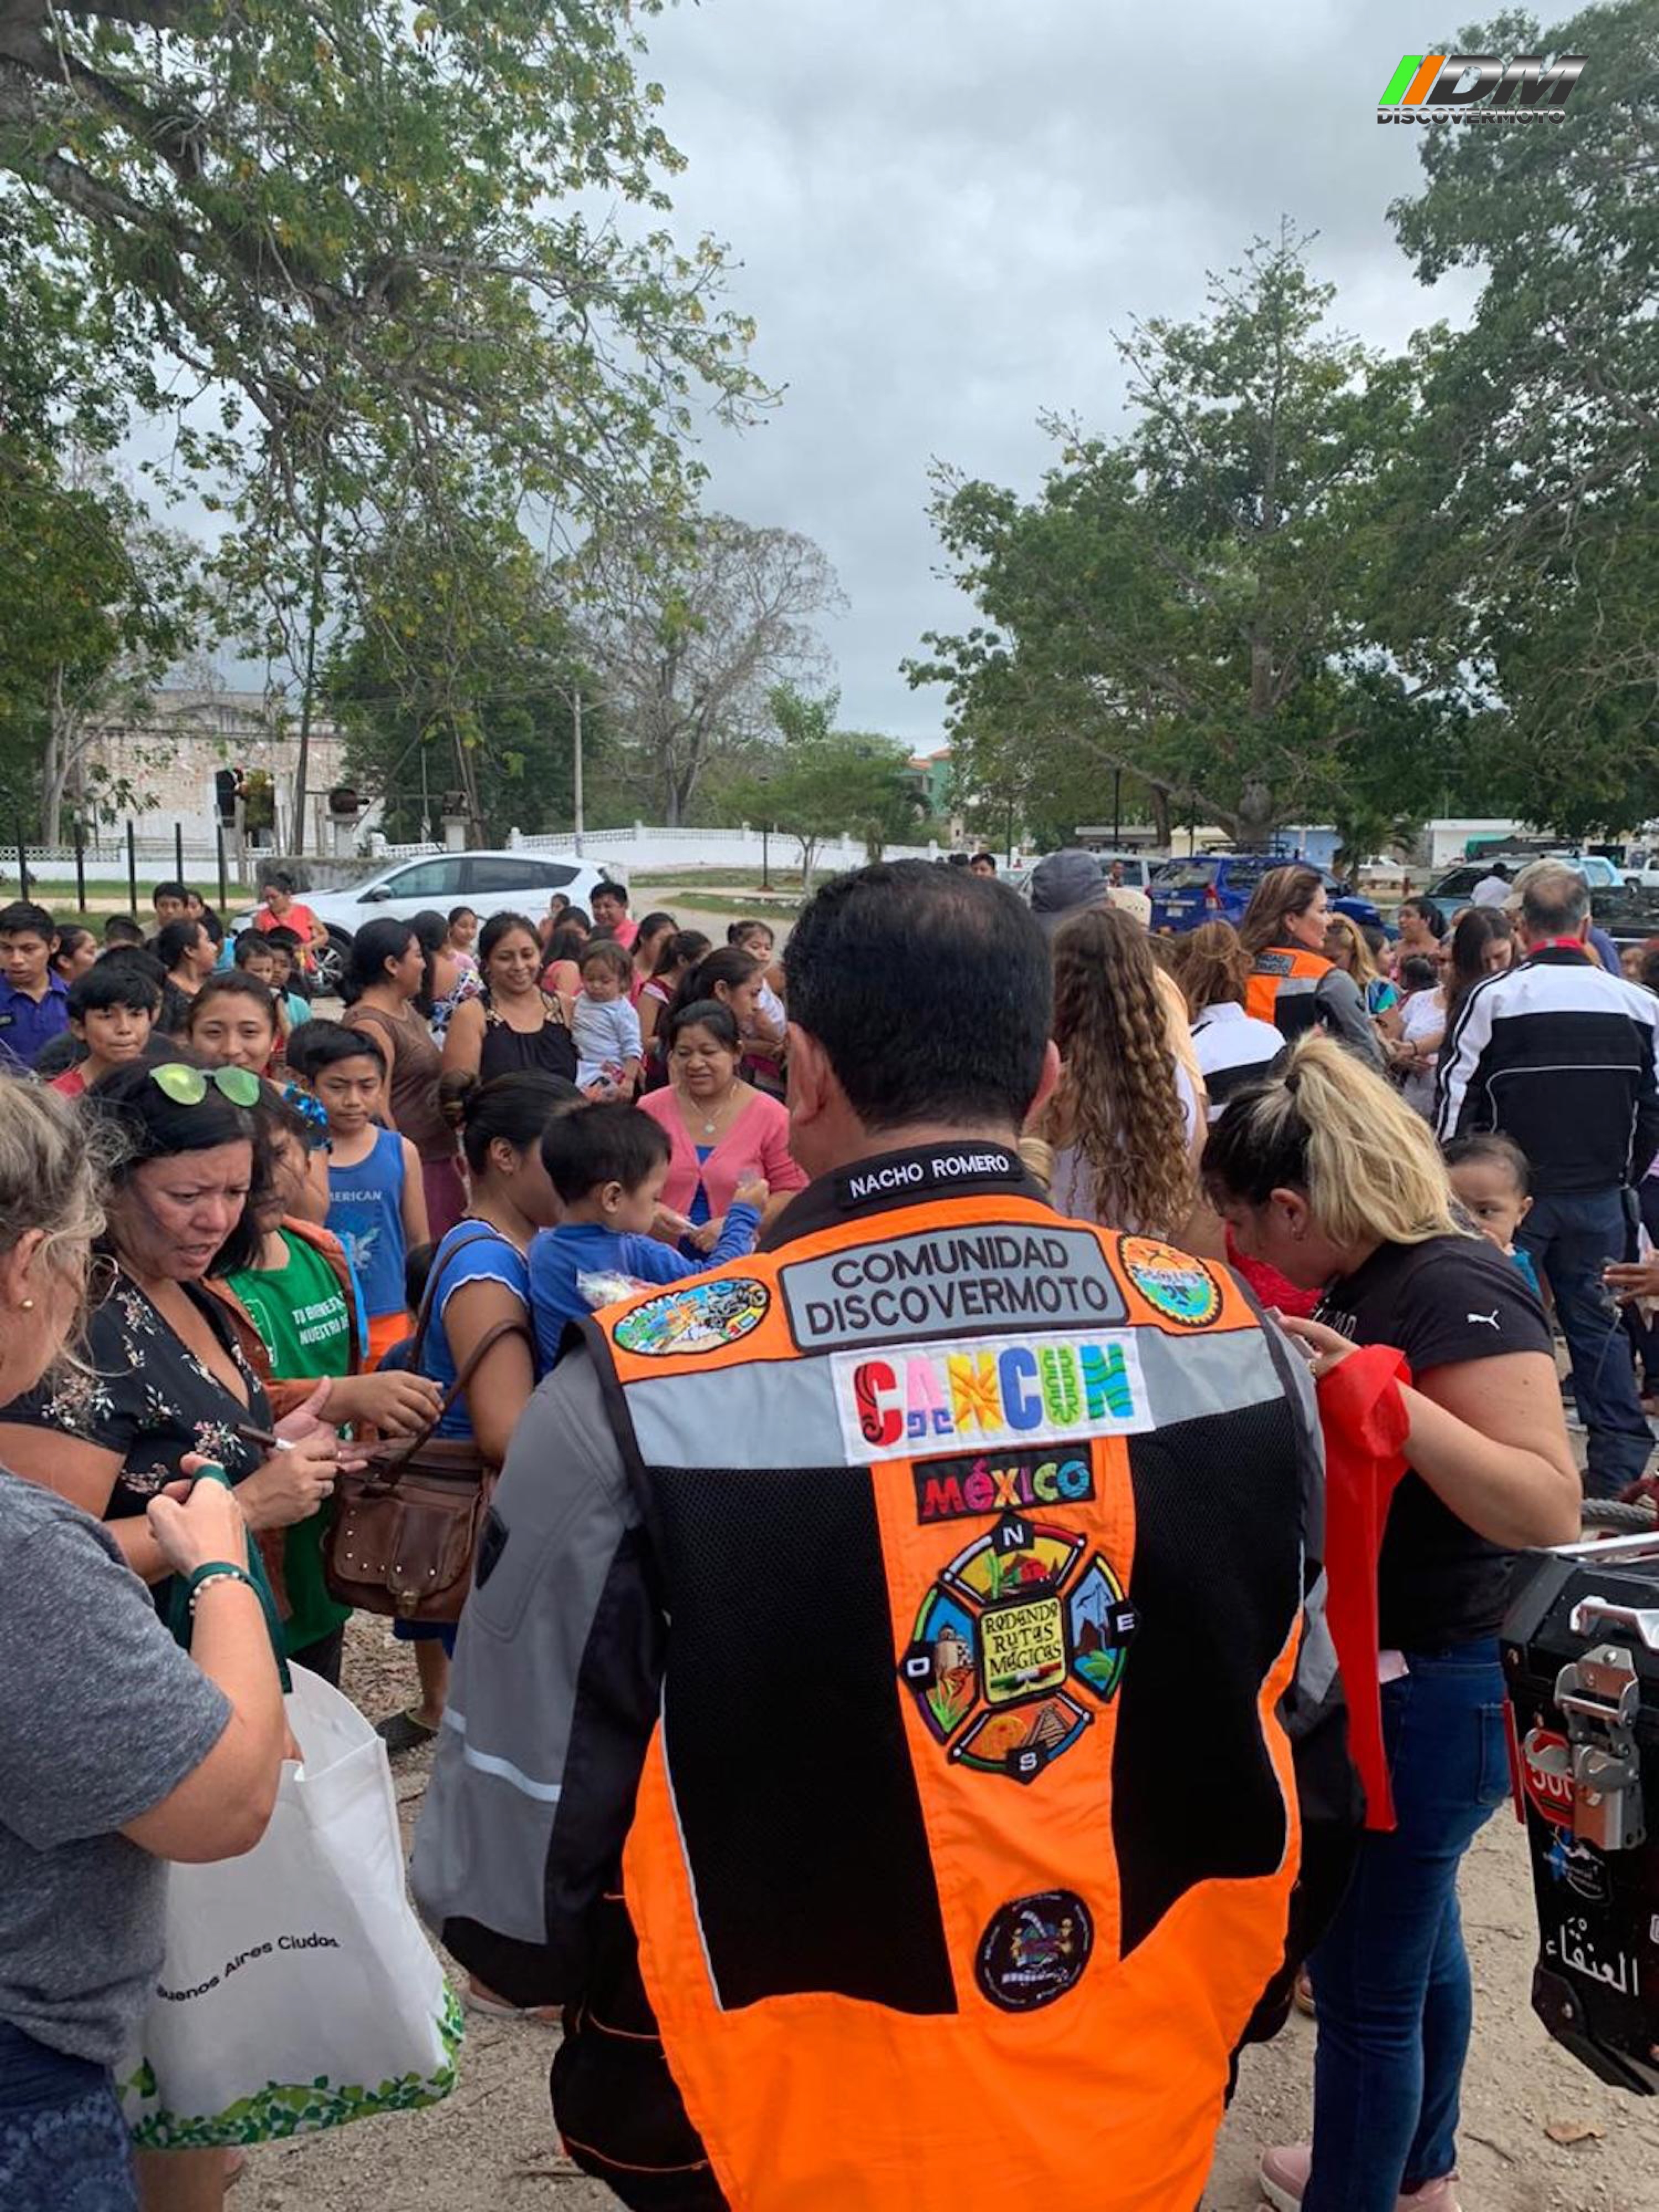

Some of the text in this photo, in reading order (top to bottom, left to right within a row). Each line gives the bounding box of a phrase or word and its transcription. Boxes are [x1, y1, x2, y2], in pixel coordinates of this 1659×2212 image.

[849, 1154, 1009, 1198] NACHO ROMERO
[831, 1236, 1068, 1289] COMUNIDAD
[805, 1275, 1108, 1335] DISCOVERMOTO
[1002, 1524, 1024, 1547] N
[1117, 1613, 1135, 1632] E
[1019, 1752, 1038, 1771] S
